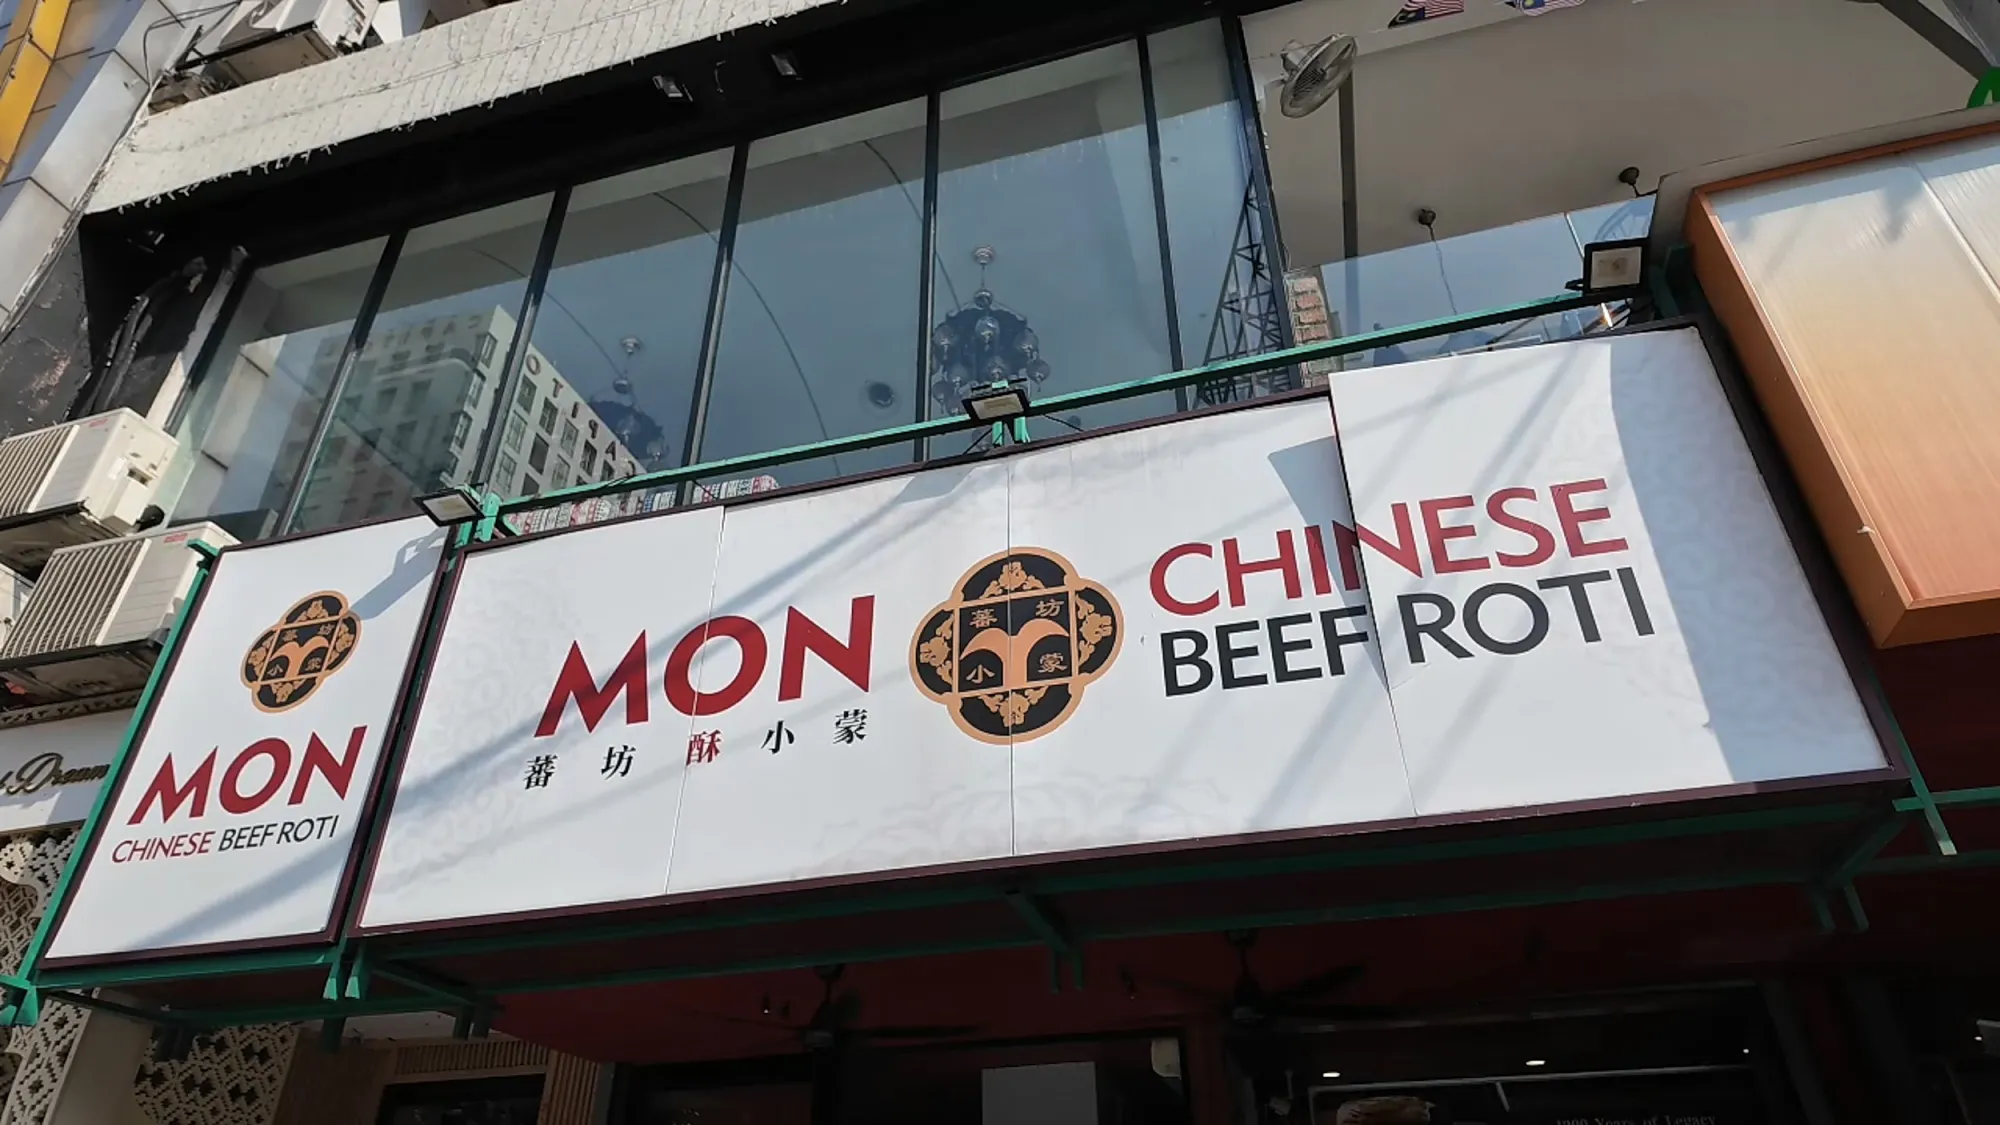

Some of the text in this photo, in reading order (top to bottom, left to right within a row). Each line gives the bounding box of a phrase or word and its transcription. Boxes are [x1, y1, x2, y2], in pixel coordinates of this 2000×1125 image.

[1149, 478, 1629, 616] CHINESE
[534, 594, 876, 738] MON
[1160, 566, 1655, 697] BEEF ROTI
[112, 815, 339, 863] CHINESE BEEF ROTI
[126, 725, 368, 826] MON
